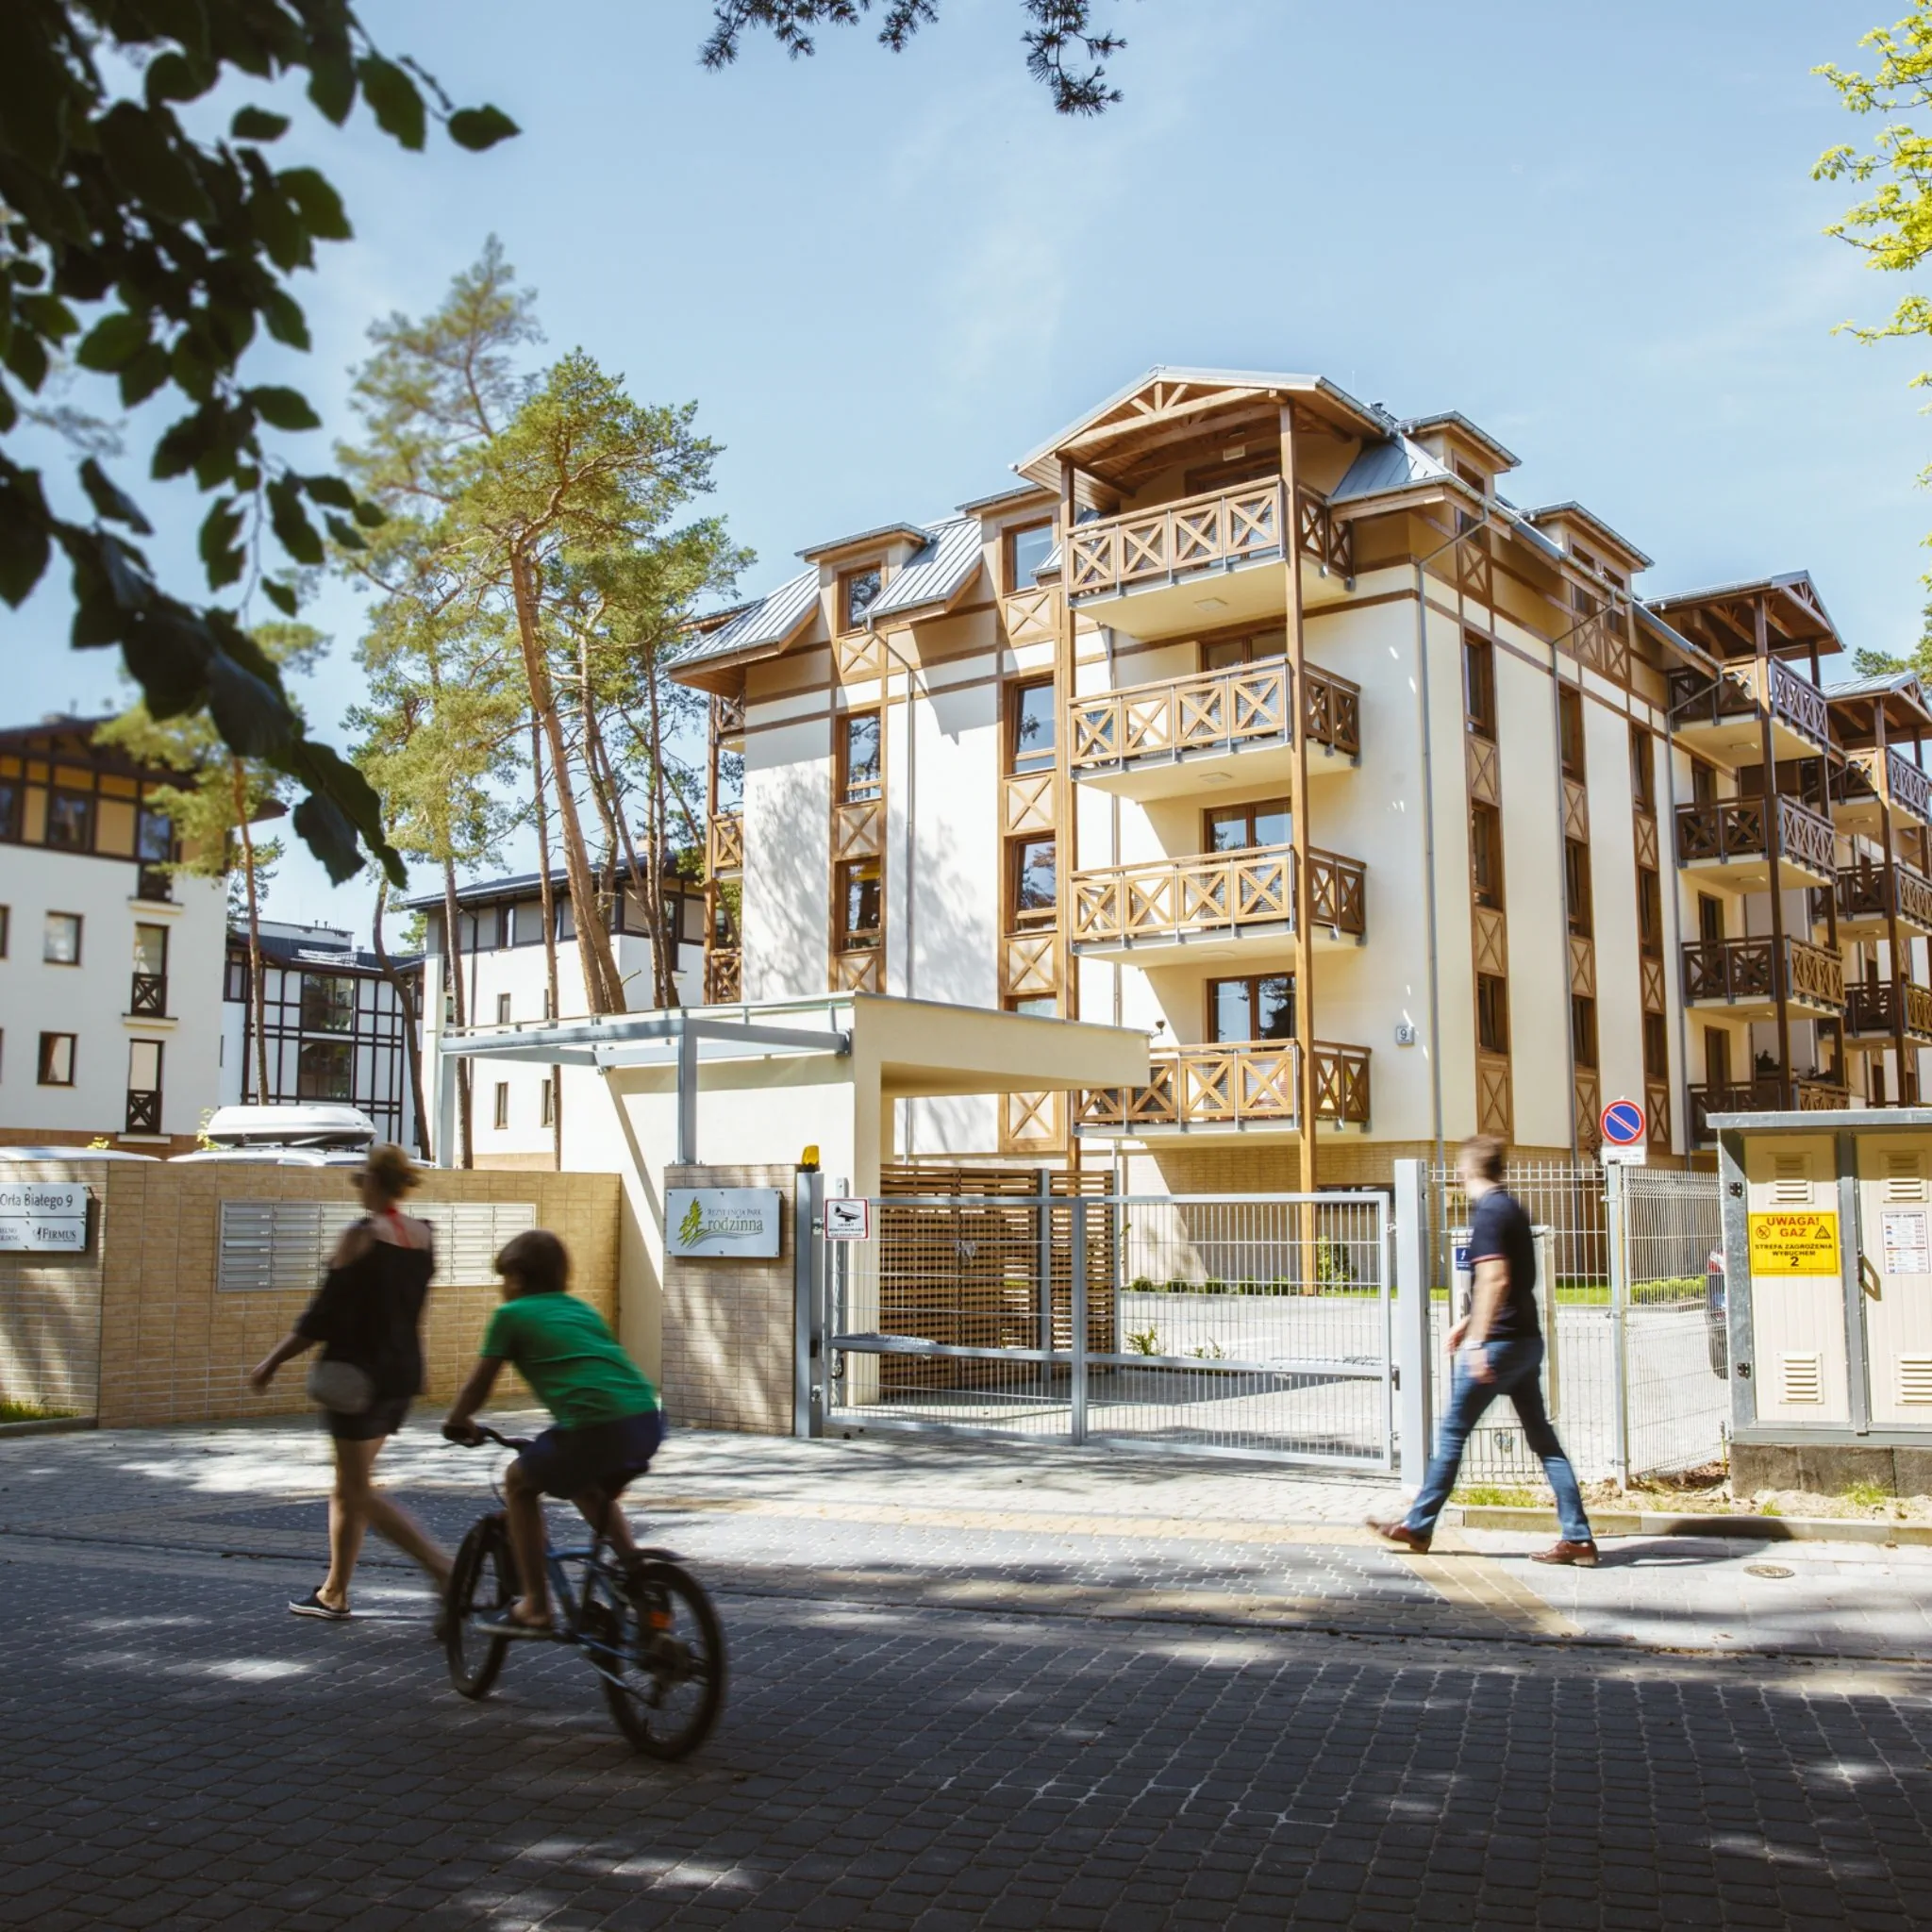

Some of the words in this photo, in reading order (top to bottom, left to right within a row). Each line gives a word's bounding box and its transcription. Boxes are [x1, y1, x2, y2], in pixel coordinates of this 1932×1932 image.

[1400, 1028, 1407, 1040] 9
[25, 1193, 64, 1210] Białego
[66, 1194, 73, 1208] 9
[708, 1216, 763, 1231] rodzinna
[1767, 1217, 1820, 1225] UWAGA!
[42, 1227, 76, 1240] FIRMUS
[1780, 1228, 1807, 1237] GAZ
[1790, 1257, 1799, 1267] 2
